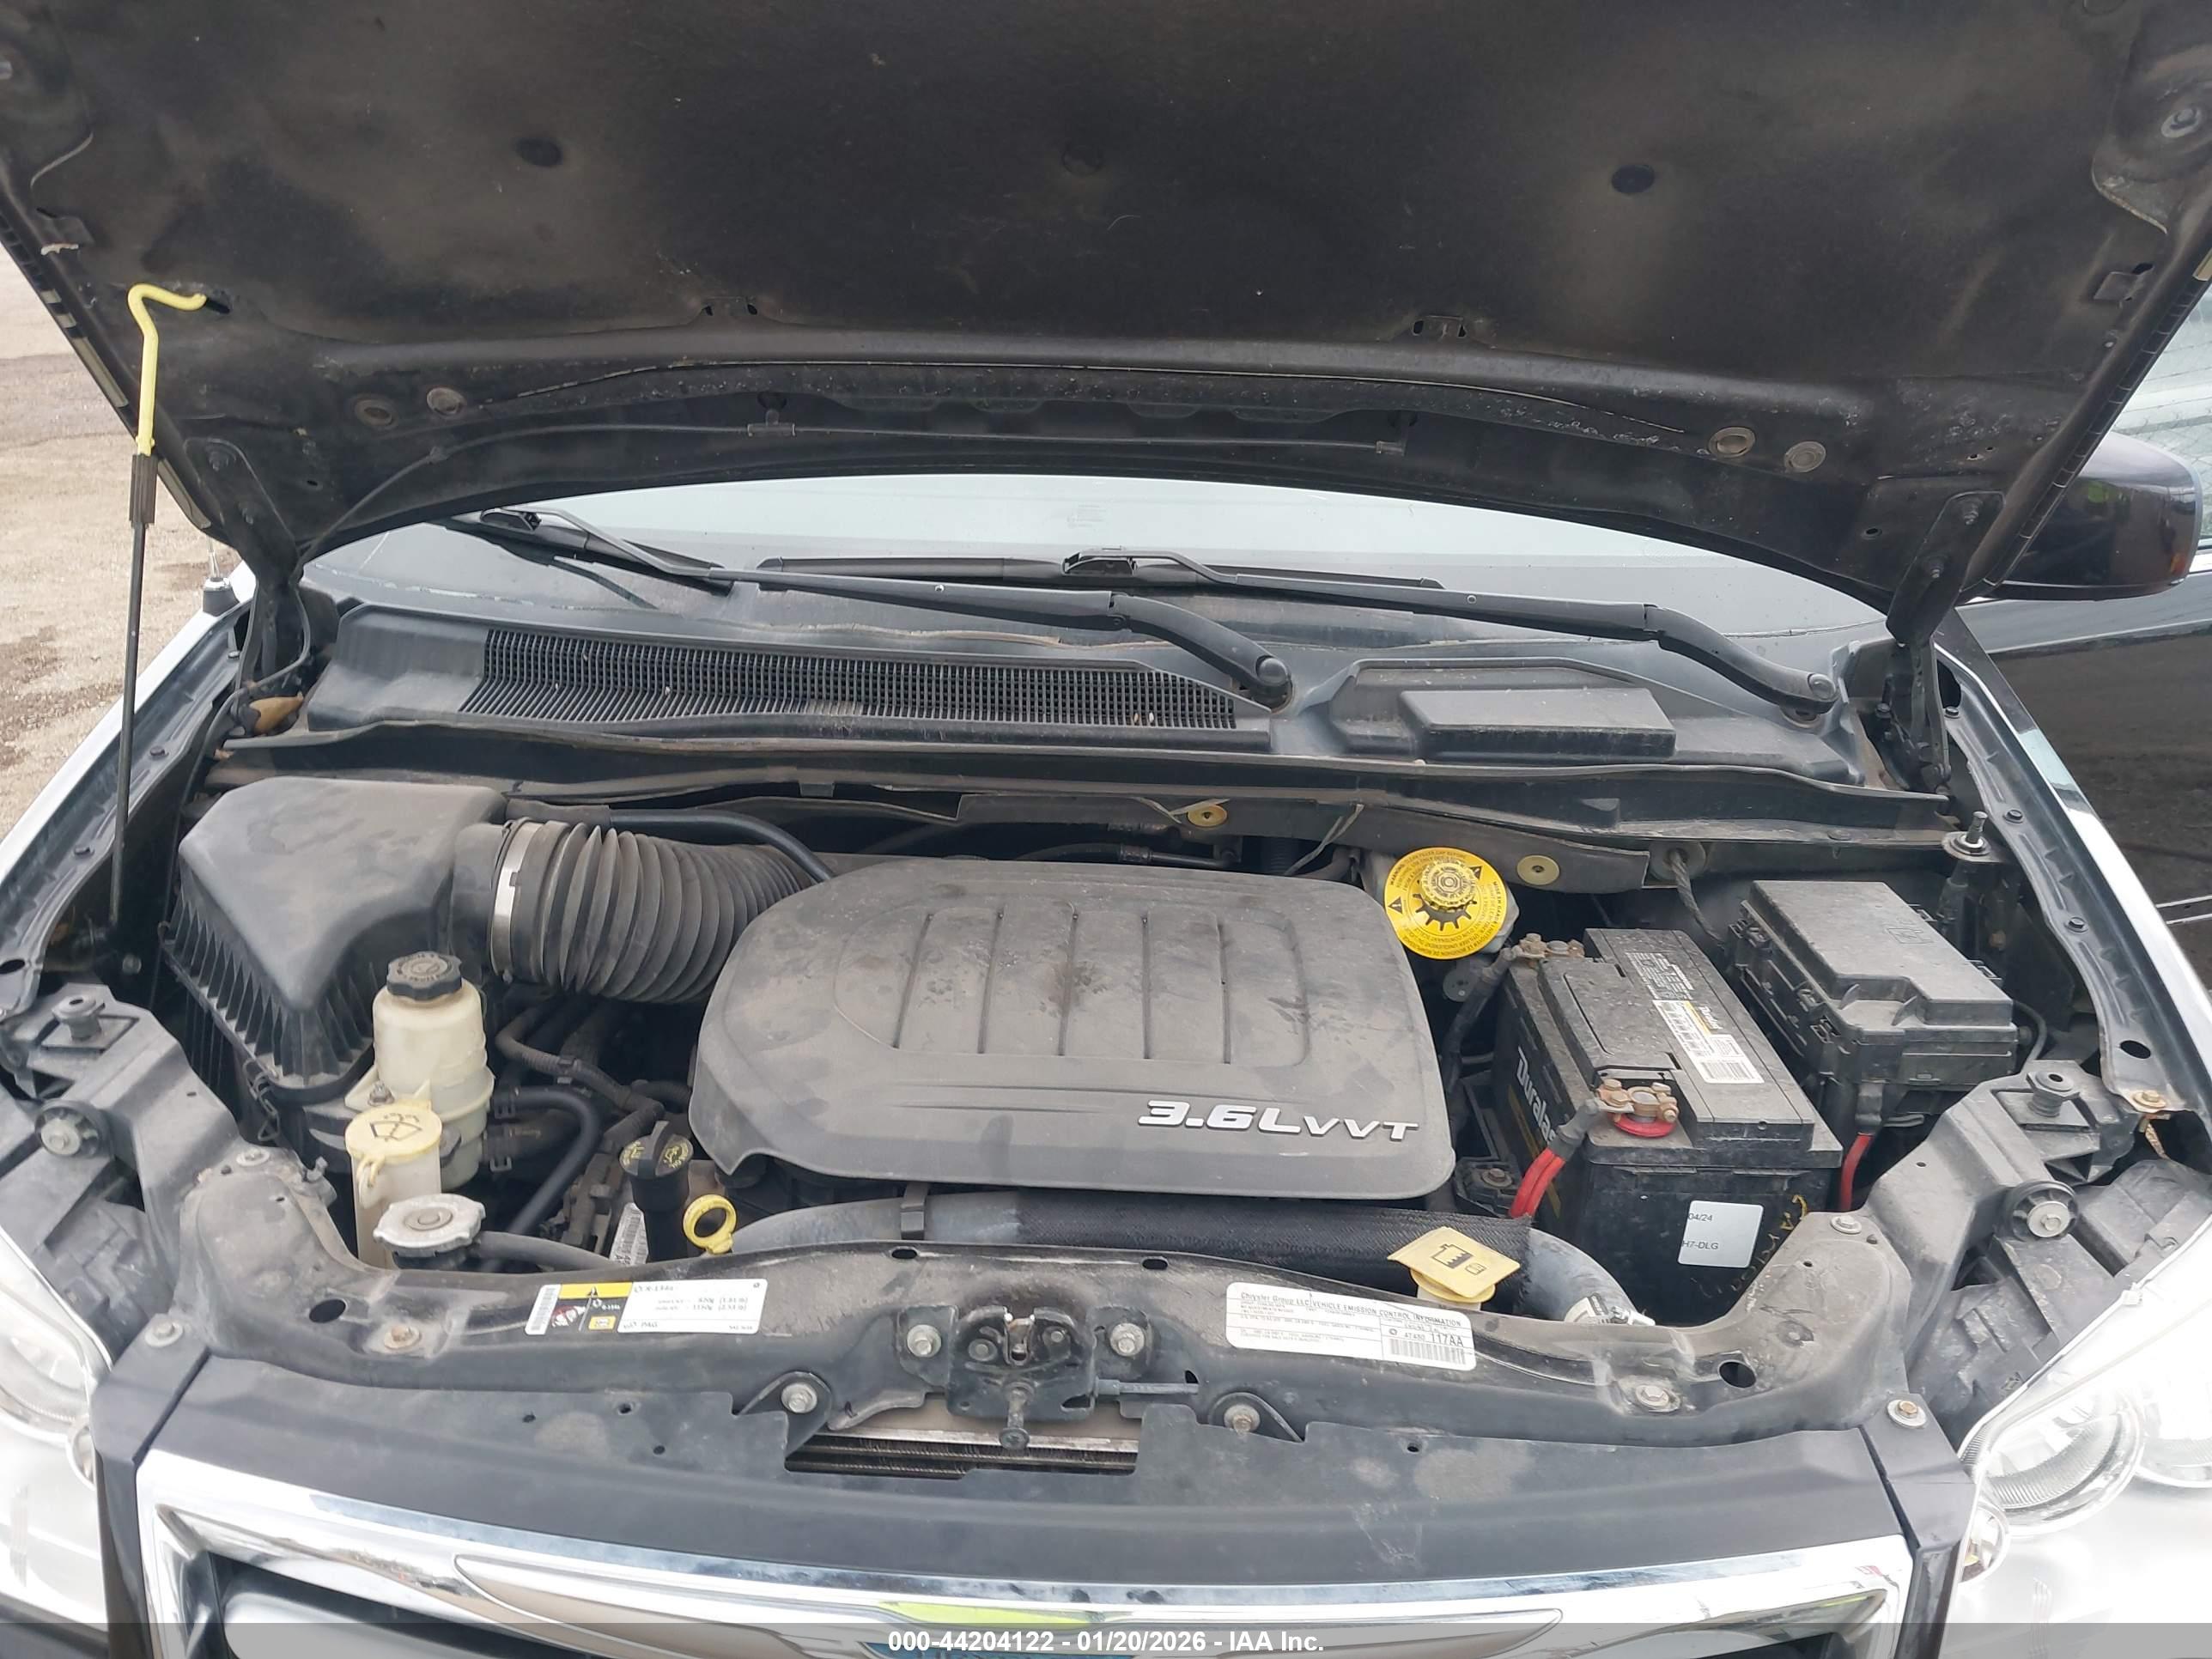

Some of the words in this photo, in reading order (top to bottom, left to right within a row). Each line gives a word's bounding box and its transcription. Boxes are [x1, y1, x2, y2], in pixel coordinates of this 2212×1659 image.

[1241, 1291, 1271, 1302] Chrysler
[1272, 1294, 1295, 1306] Group
[1296, 1297, 1310, 1307] LLC
[1312, 1299, 1341, 1310] VEHICLE
[1343, 1304, 1378, 1316] EMISSION
[1378, 1309, 1411, 1321] CONTROL
[1413, 1314, 1462, 1328] INFORMATION
[1431, 1332, 1465, 1347] 117AA
